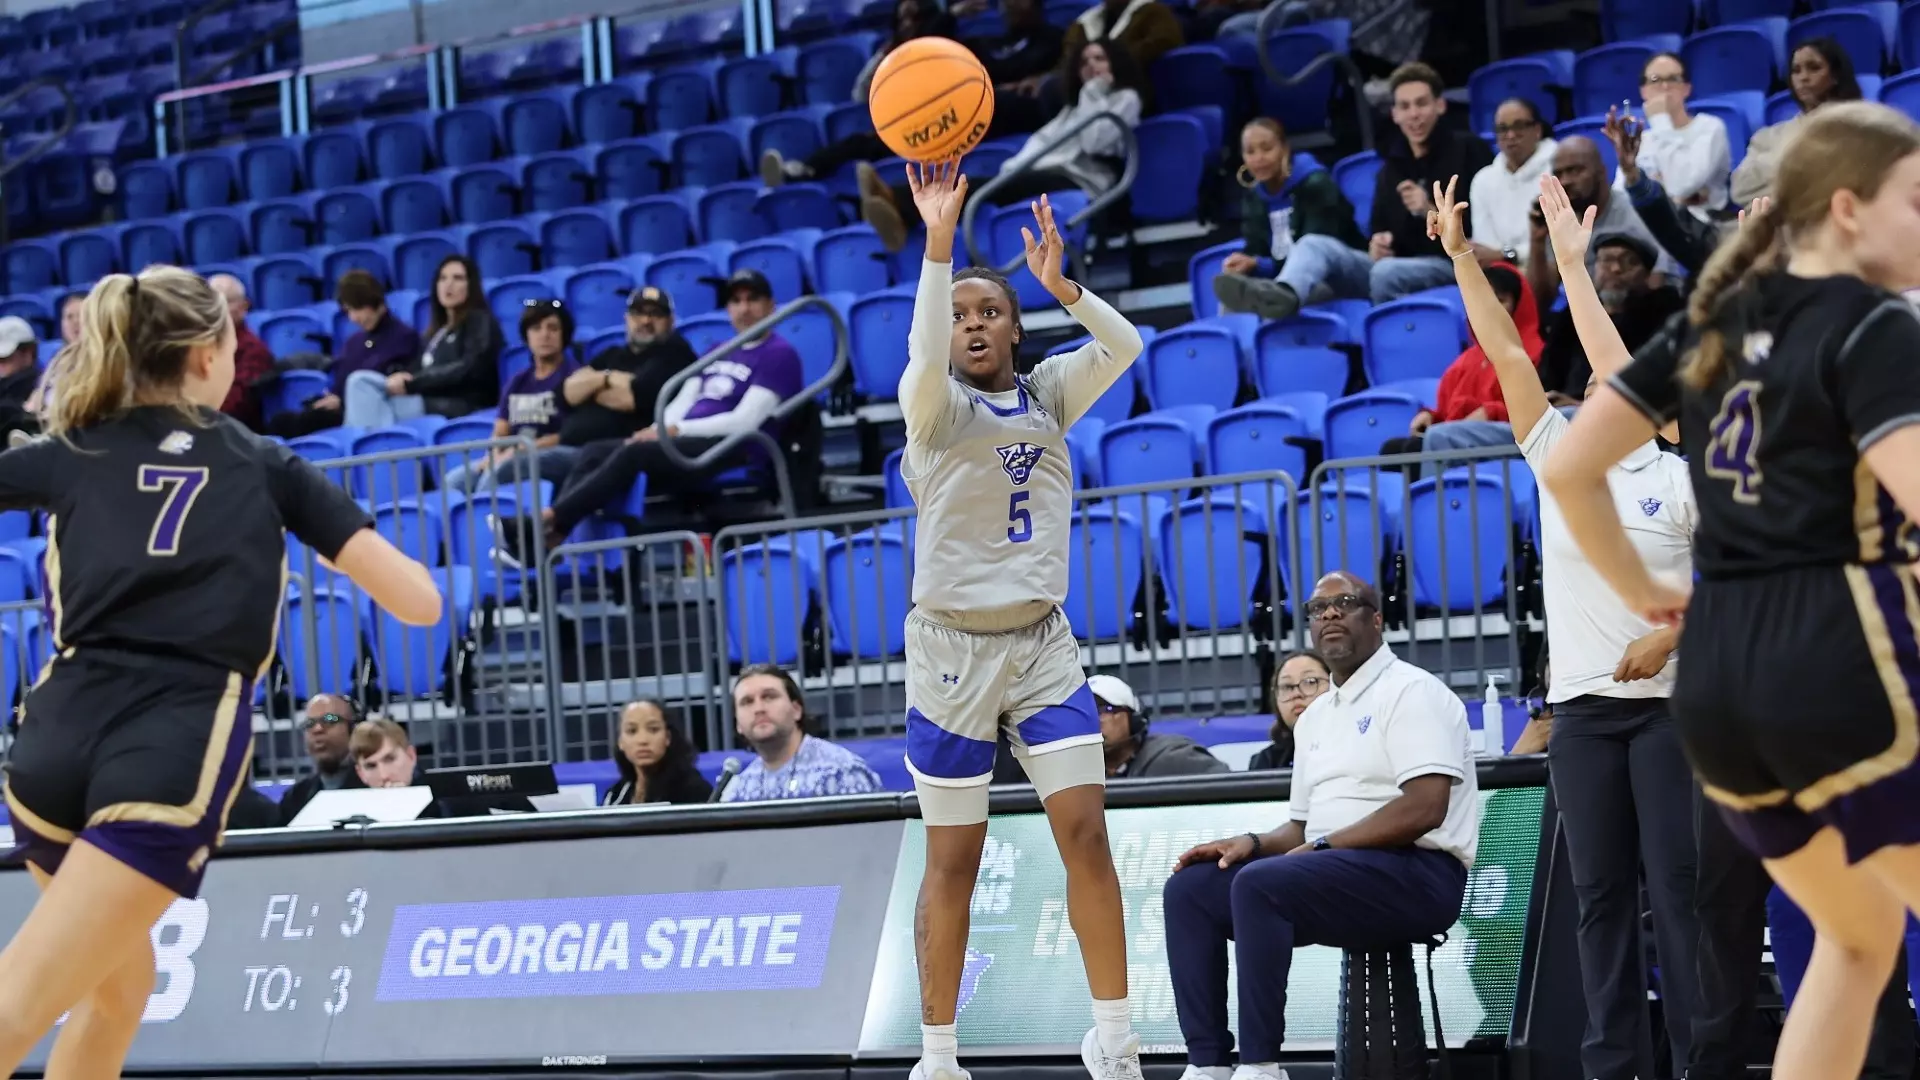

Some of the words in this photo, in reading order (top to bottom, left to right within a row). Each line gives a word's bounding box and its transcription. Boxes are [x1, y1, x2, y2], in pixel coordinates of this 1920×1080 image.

[904, 107, 959, 147] NCAA
[1705, 380, 1763, 504] 4
[137, 464, 209, 556] 7
[1007, 491, 1032, 543] 5
[260, 893, 320, 941] FL:
[340, 887, 368, 938] 3
[408, 921, 630, 978] GEORGIA
[640, 912, 802, 970] STATE
[243, 964, 302, 1012] TO:
[323, 965, 352, 1016] 3
[541, 1054, 608, 1066] DAKTRONICS
